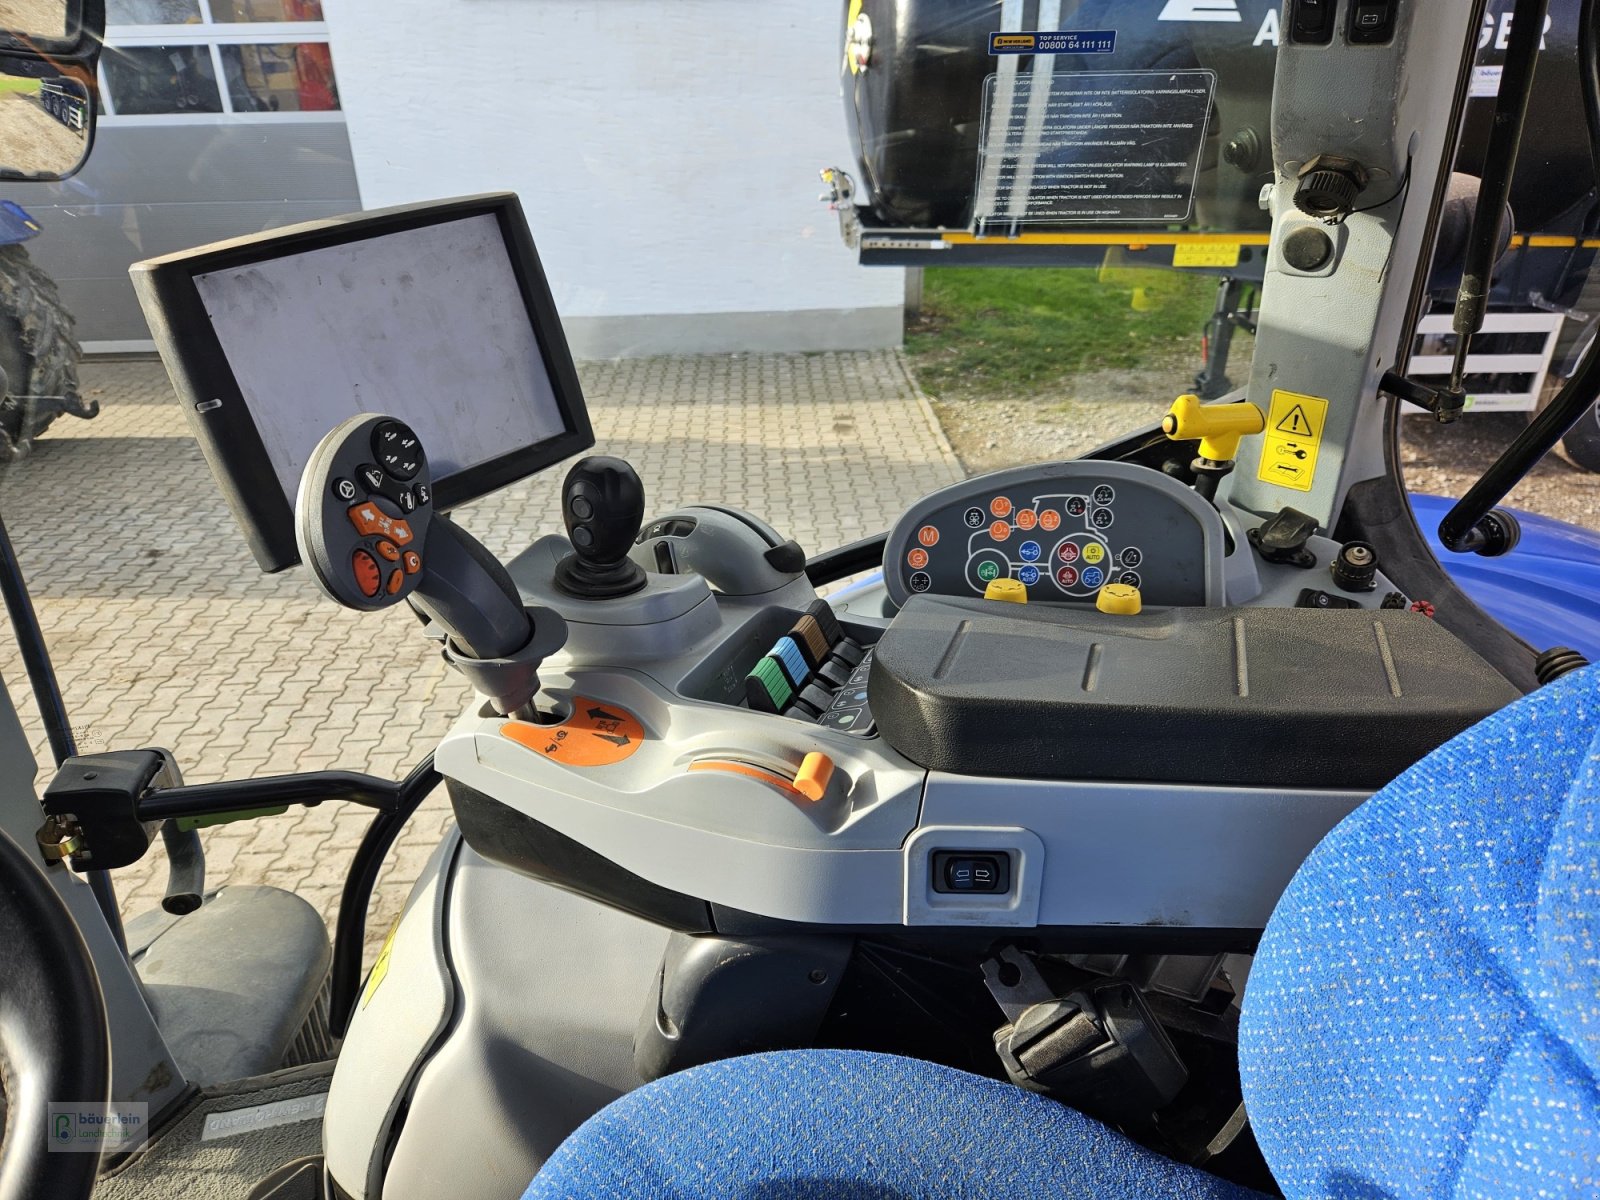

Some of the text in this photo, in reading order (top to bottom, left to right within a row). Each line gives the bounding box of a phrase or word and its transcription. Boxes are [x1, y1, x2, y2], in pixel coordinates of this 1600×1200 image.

[1038, 40, 1111, 50] 00800 64 111 111
[924, 530, 934, 542] M
